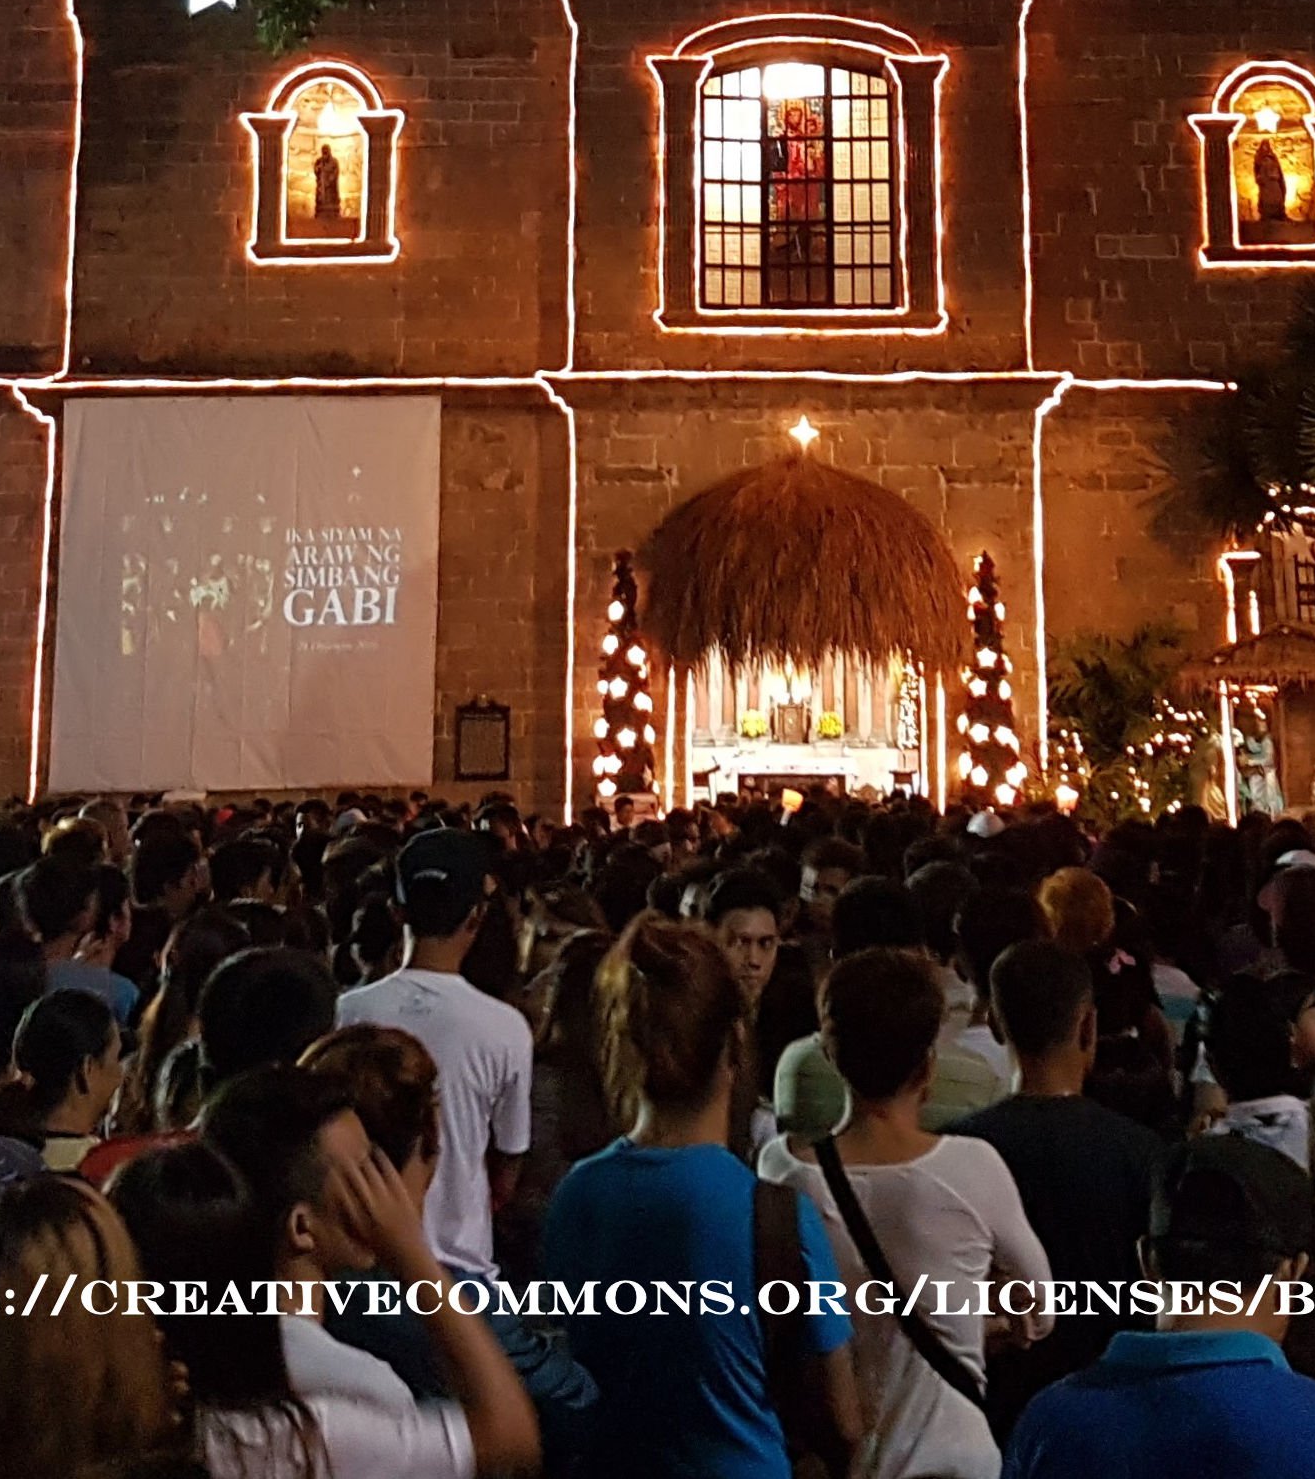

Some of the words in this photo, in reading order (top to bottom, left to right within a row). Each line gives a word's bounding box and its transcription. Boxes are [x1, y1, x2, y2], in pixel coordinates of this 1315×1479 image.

[379, 526, 403, 541] NA
[285, 543, 358, 565] ARAW
[366, 543, 401, 564] NG
[283, 564, 401, 588] SIMBANG
[282, 586, 398, 627] GABI
